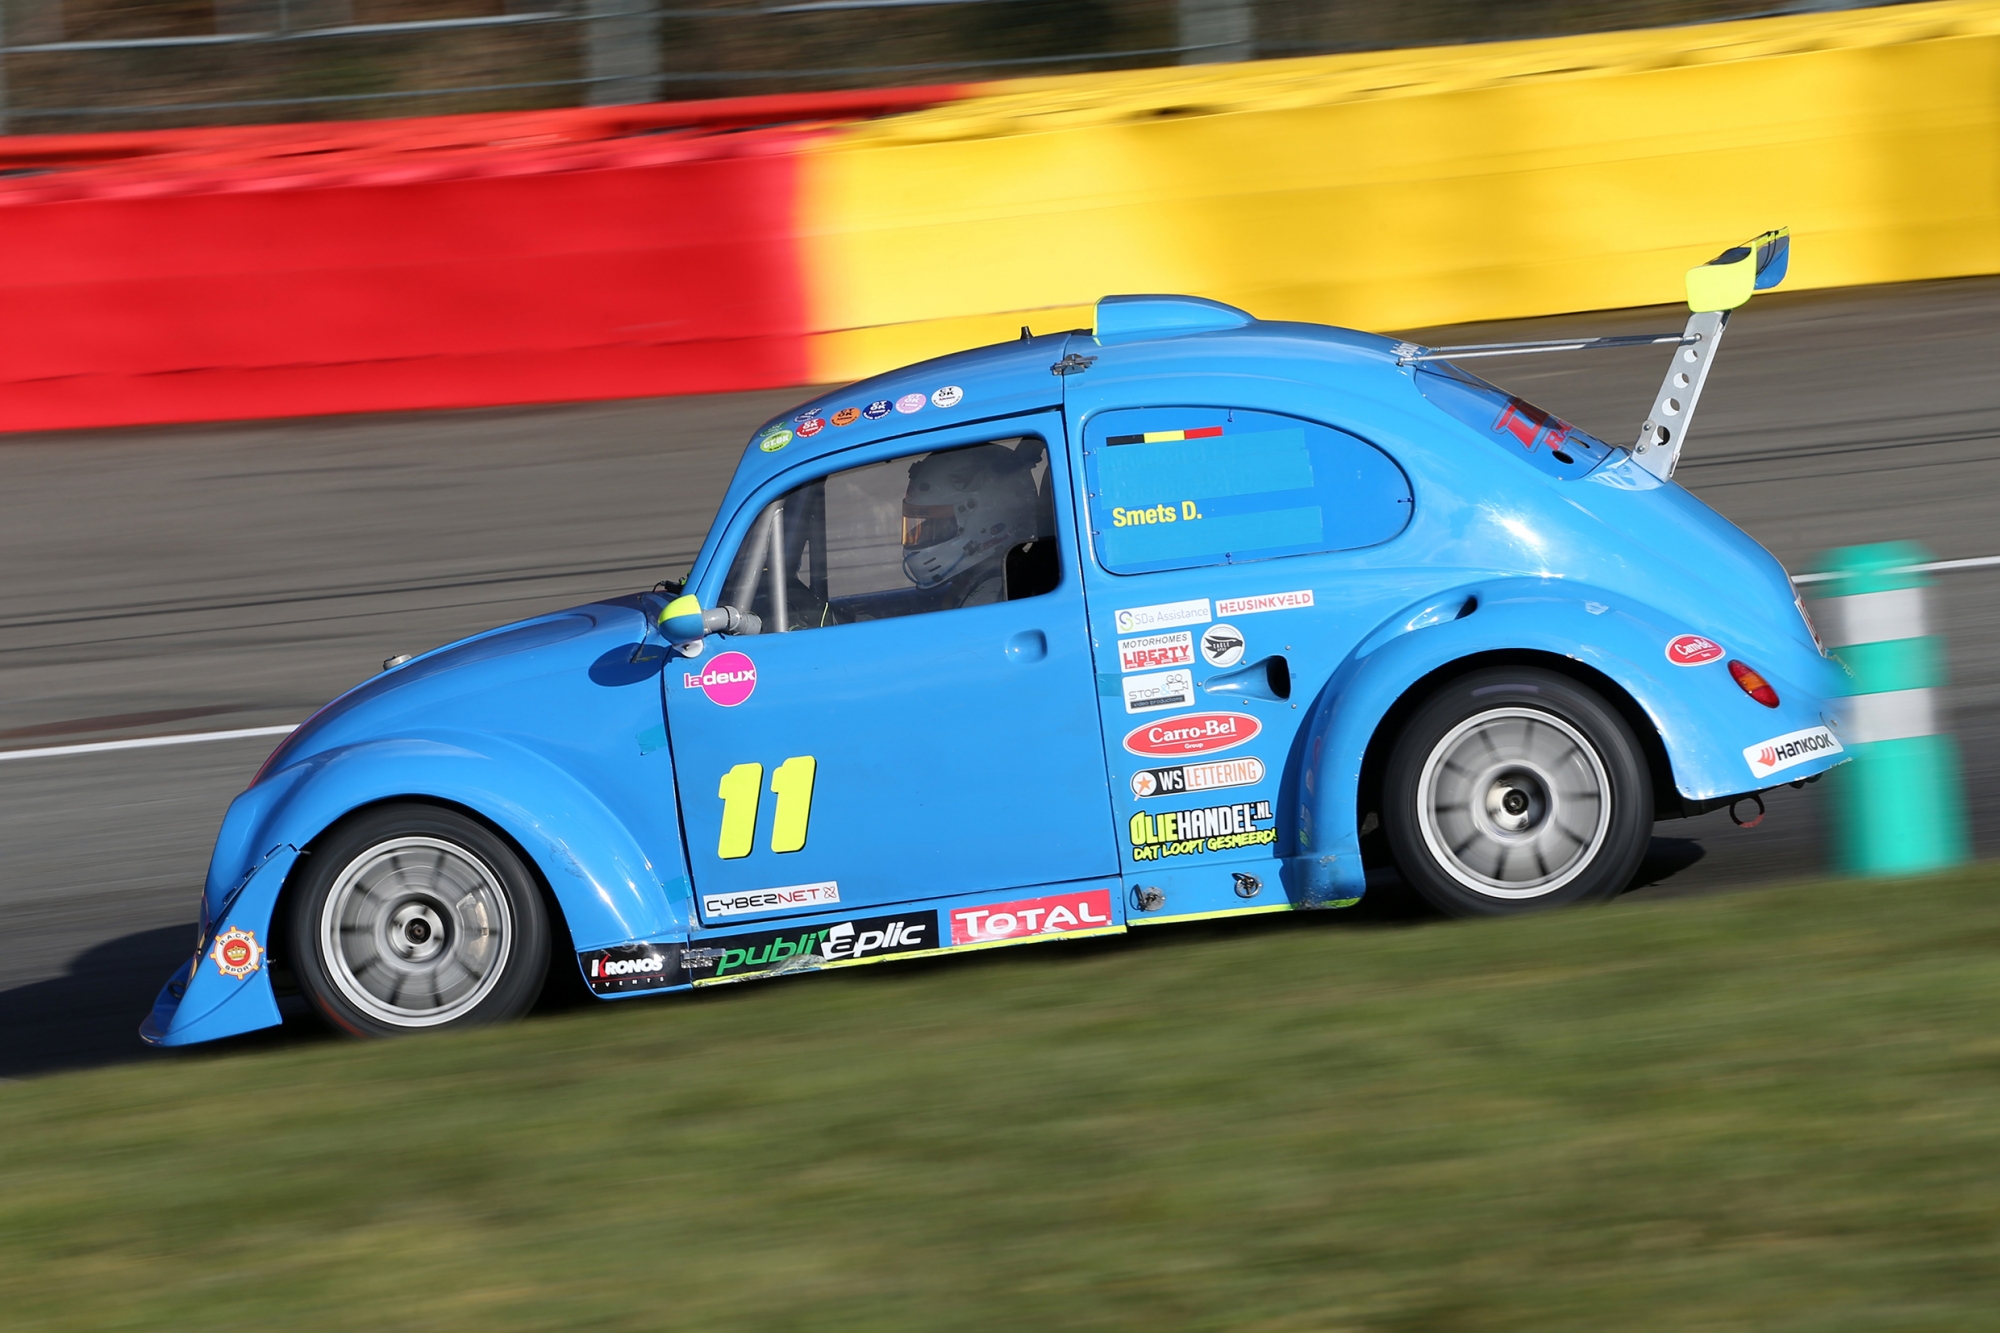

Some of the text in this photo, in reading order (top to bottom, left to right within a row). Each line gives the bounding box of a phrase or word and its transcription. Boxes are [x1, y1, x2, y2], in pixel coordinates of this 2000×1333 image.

[1112, 501, 1203, 527] Smets D.
[1219, 593, 1311, 614] HEUSINKVELD
[1134, 606, 1209, 626] SDa Assistance
[1122, 633, 1188, 649] MOTORHOMES
[1123, 644, 1189, 669] LIBERTY
[1133, 696, 1184, 707] video productions
[1148, 717, 1237, 743] Carro-Bel
[1184, 742, 1204, 750] Group
[1186, 761, 1257, 787] LETTERING
[718, 755, 817, 860] 11
[1133, 828, 1278, 861] DAT LOOPT GESMEERD!
[706, 888, 820, 912] CYBERNET
[955, 902, 1107, 938] TOTAL
[225, 962, 253, 973] SPORT
[591, 954, 665, 978] KRONOS
[592, 976, 664, 989] EVENTS
